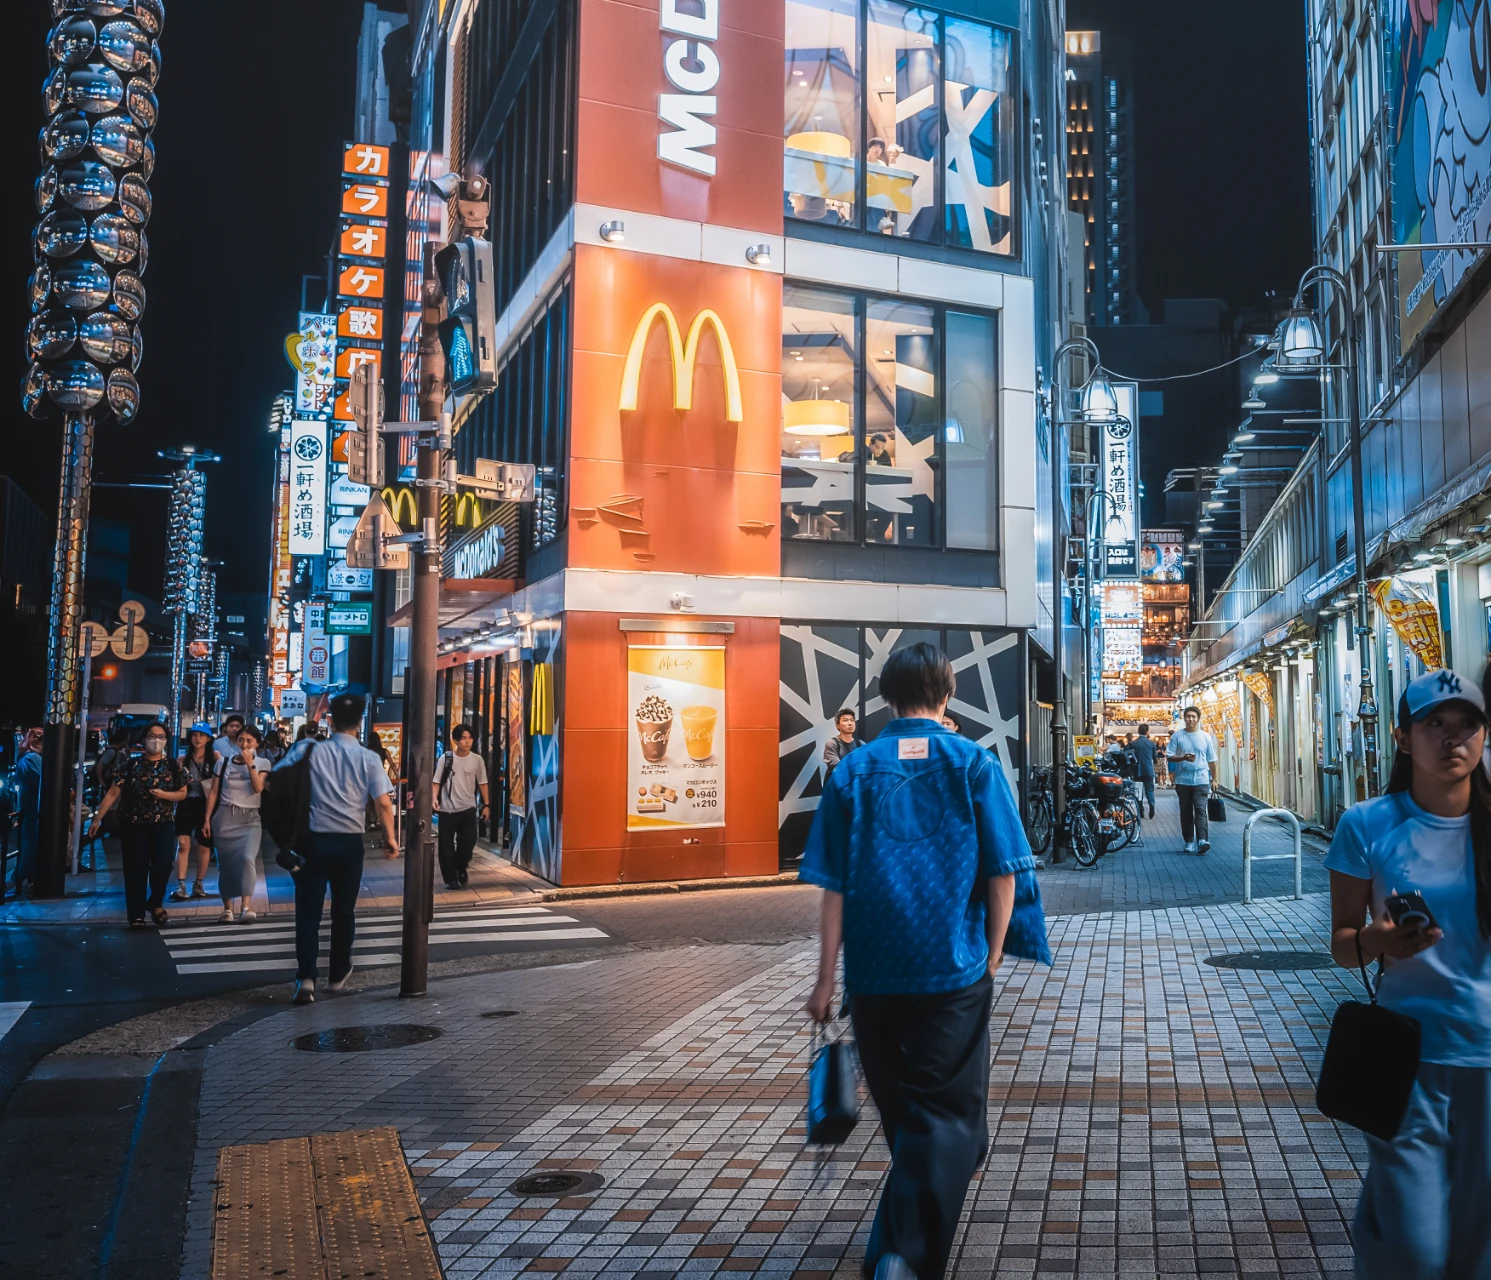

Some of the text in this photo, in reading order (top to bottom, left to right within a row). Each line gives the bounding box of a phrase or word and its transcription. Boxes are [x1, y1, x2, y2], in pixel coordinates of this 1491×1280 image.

[346, 147, 382, 412] カラオケ歌広
[293, 464, 315, 540] 一軒め酒場
[1109, 441, 1127, 512] 一軒め酒場
[453, 524, 502, 579] McDonald's
